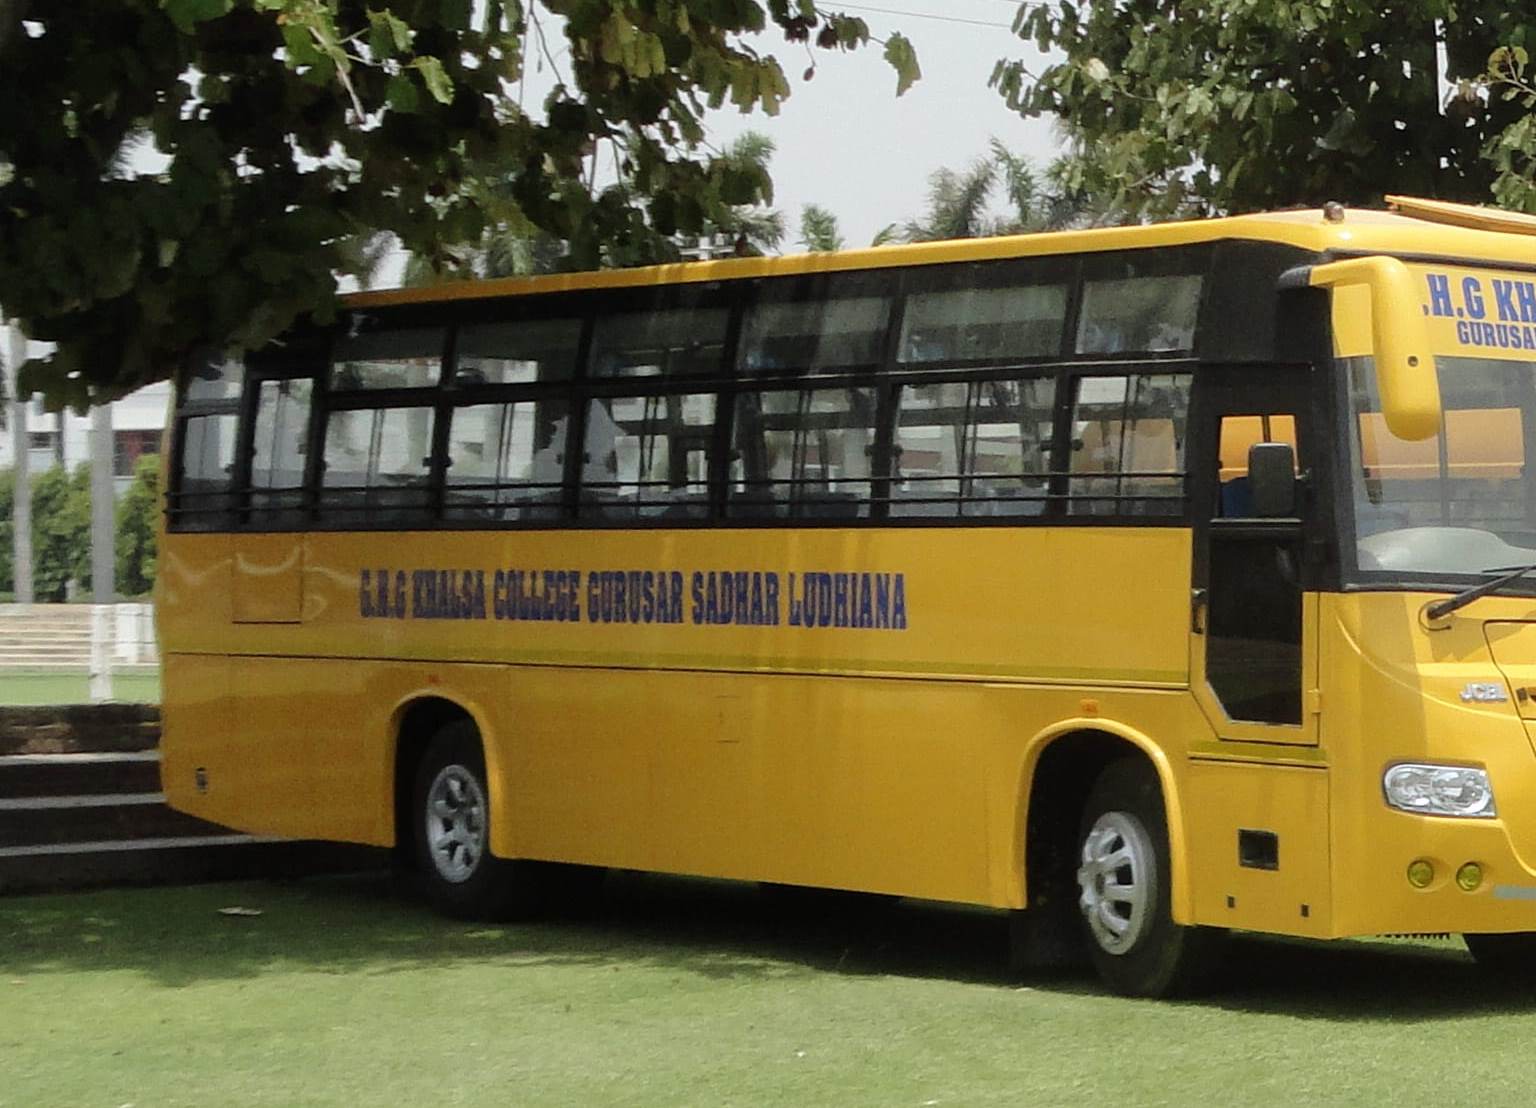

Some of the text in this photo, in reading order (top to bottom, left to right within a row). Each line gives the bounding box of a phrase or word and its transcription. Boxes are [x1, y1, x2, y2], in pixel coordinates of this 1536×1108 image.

[412, 569, 486, 620] KHALSA
[494, 569, 581, 622] COLLEGE
[587, 570, 684, 624] GURUSAR
[692, 571, 779, 626] SADHAR
[788, 571, 907, 630] LUDHIANA
